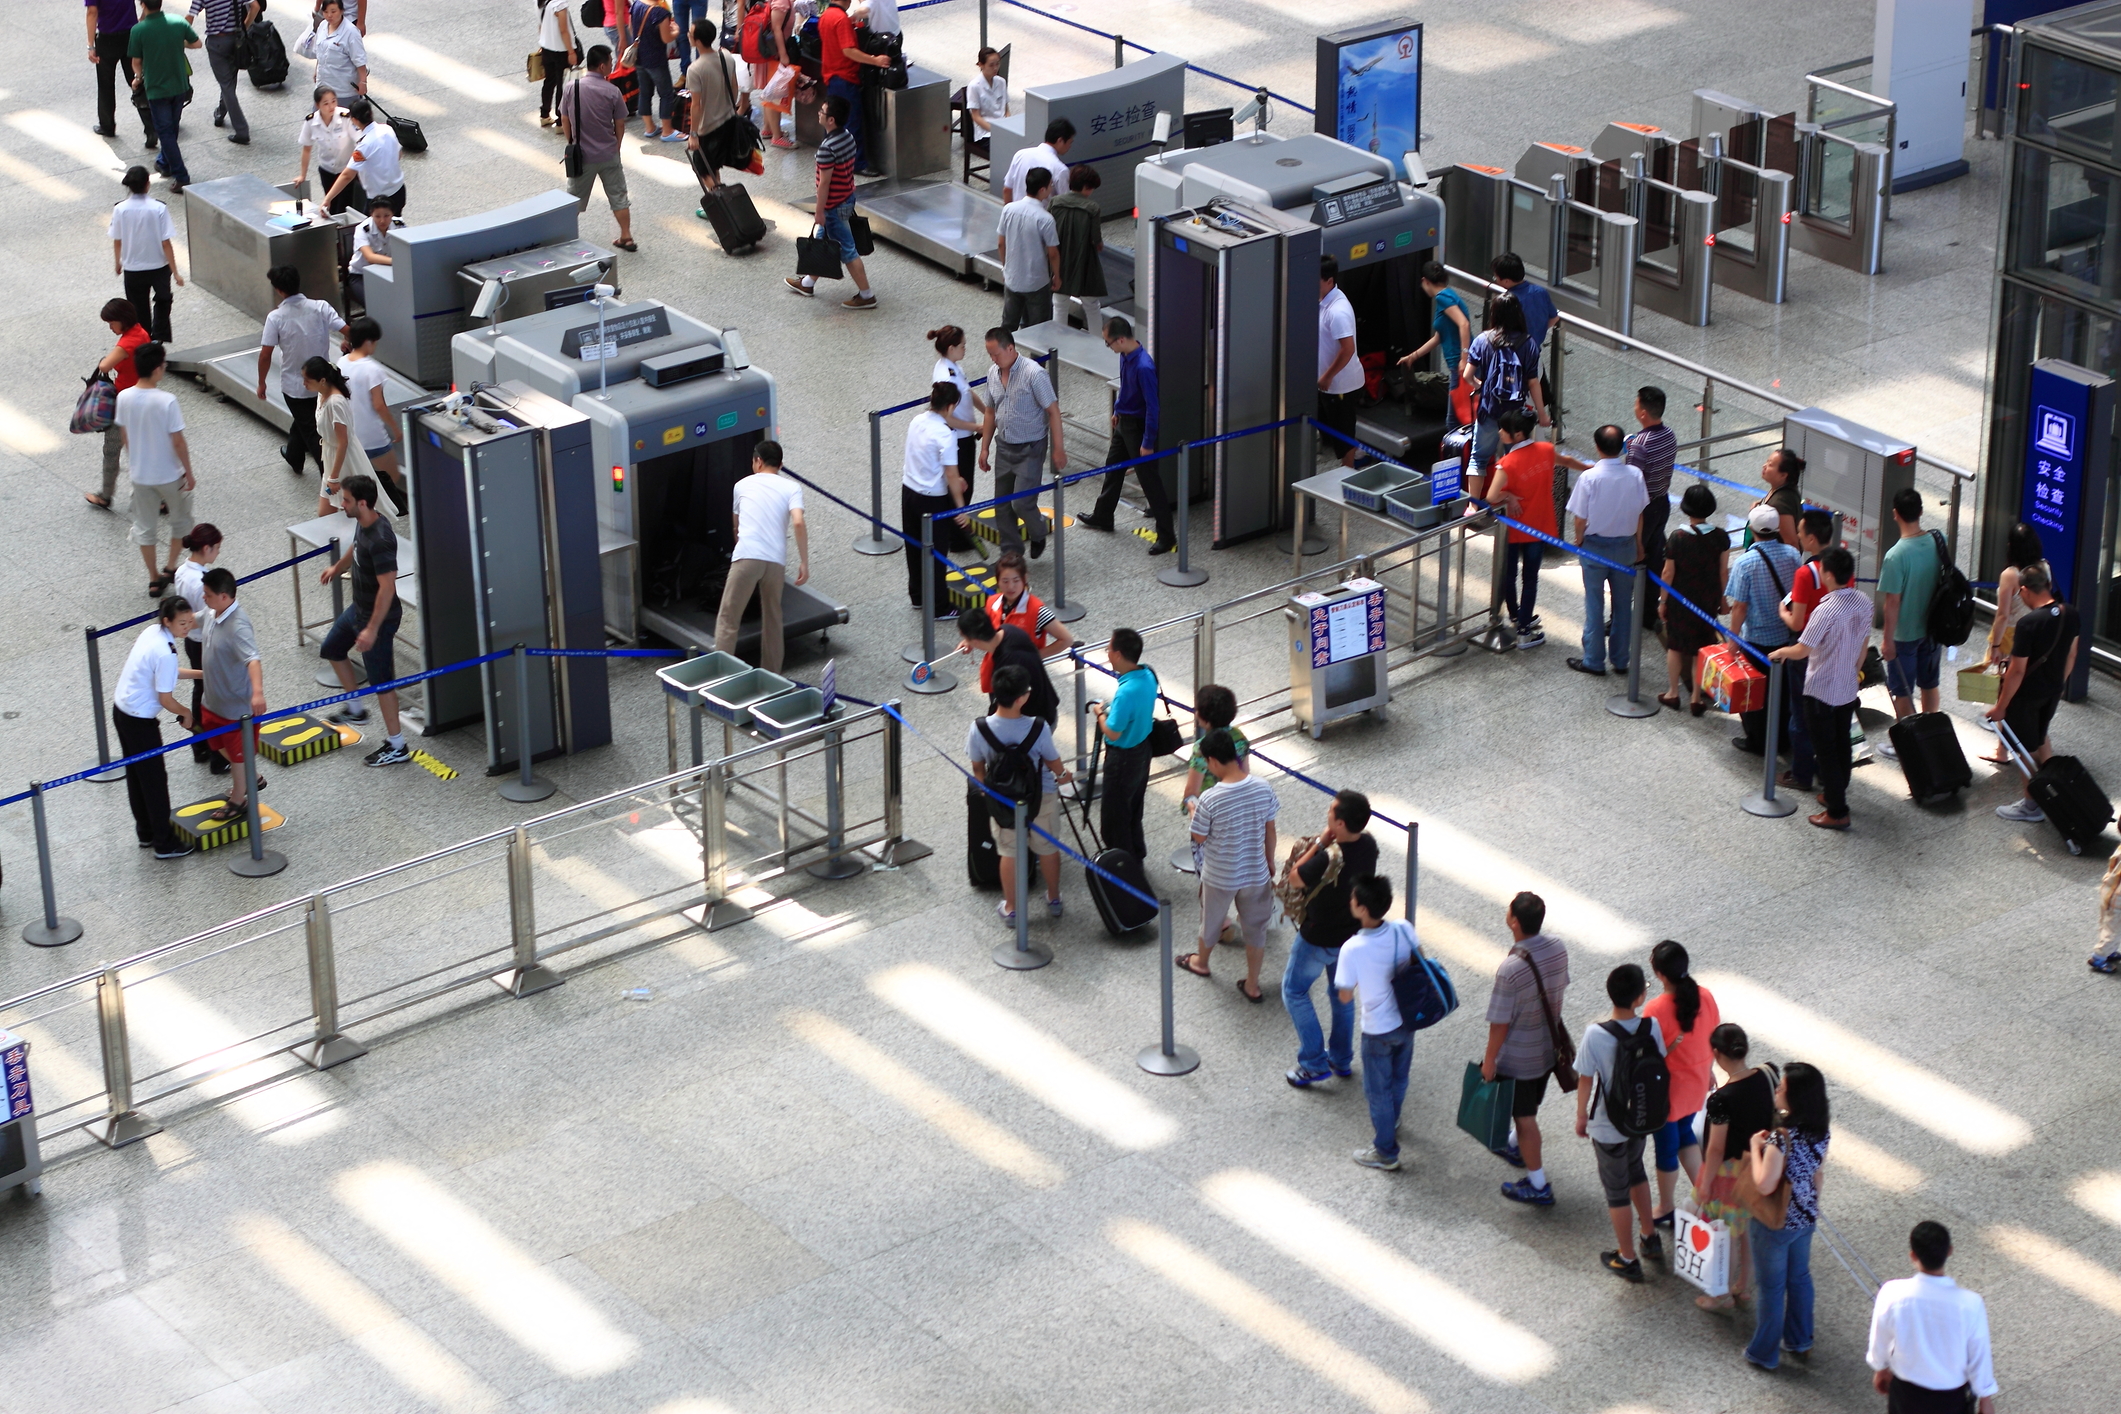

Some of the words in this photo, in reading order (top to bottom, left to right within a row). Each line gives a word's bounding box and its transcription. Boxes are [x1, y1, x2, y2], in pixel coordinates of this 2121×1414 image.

[1091, 100, 1156, 136] 安全检查
[1114, 131, 1144, 147] SECURITY
[1375, 241, 1385, 251] 05
[695, 424, 706, 434] 04
[2038, 460, 2066, 483] 安全
[2035, 481, 2065, 505] 检查
[2035, 500, 2063, 518] Security
[2032, 512, 2064, 532] Checking
[1367, 592, 1385, 651] 丢弃刀具
[1312, 608, 1330, 667] 免于问责
[4, 1047, 31, 1117] 丢弃刀具
[1635, 1082, 1647, 1127] OIWAS
[1677, 1217, 1690, 1244] I
[1676, 1244, 1705, 1282] SH
